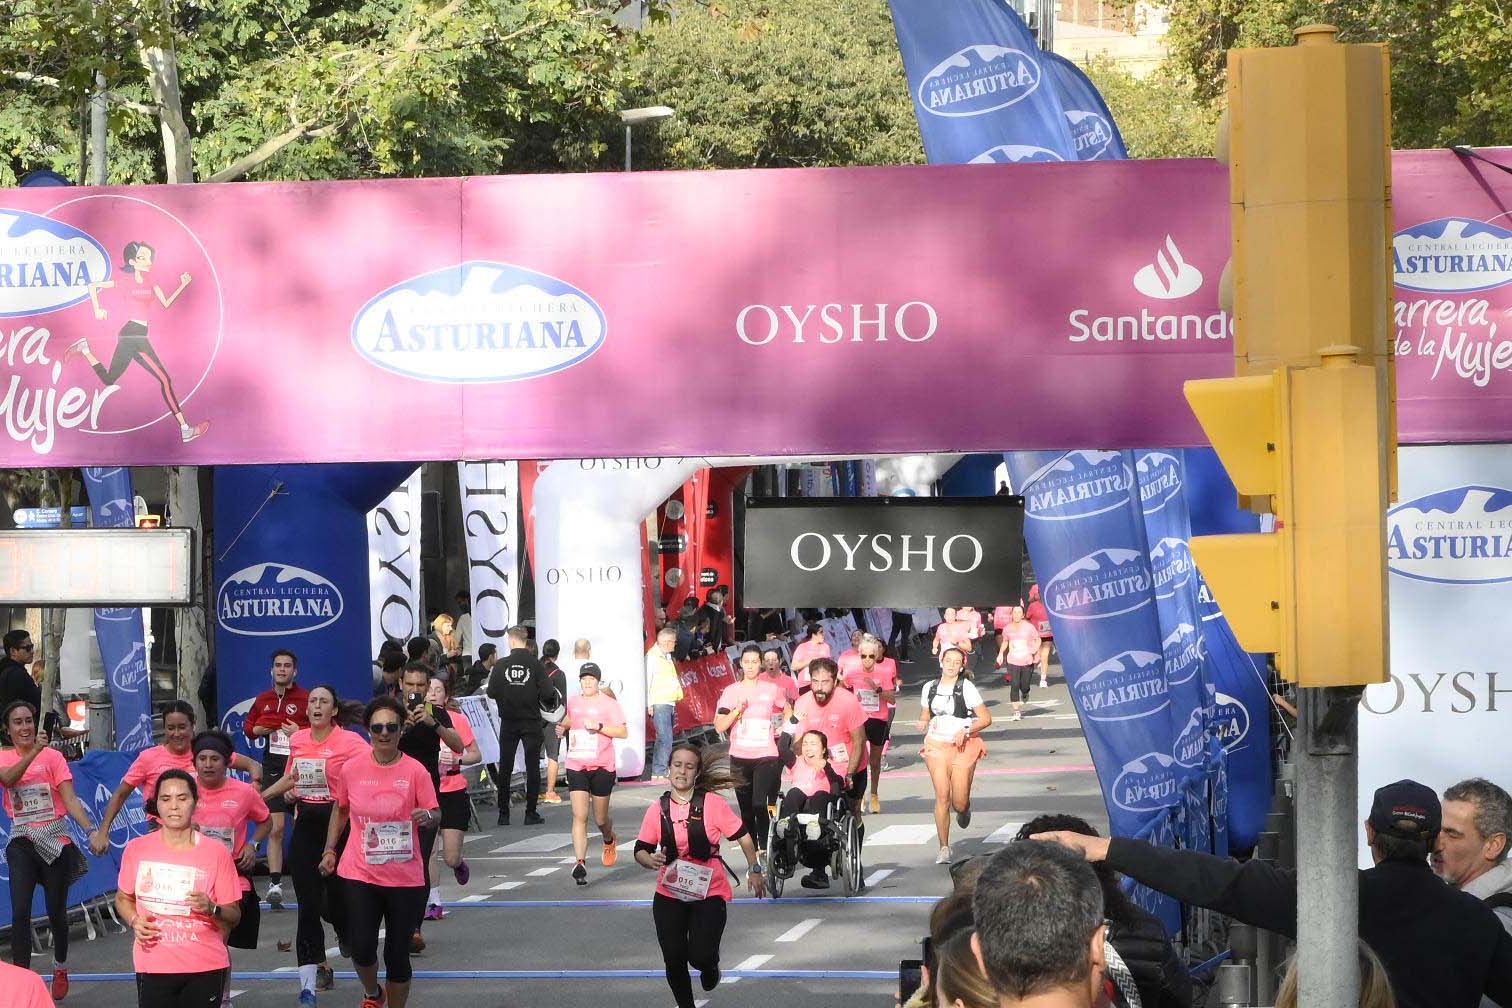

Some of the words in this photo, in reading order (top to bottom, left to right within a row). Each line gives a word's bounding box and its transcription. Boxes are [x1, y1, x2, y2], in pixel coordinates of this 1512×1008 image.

[14, 245, 87, 255] LECHERA
[1408, 243, 1457, 252] CENTRAL
[373, 307, 588, 352] ASTURIANA
[736, 301, 938, 345] OYSHO
[1068, 308, 1233, 342] Santand
[1418, 328, 1435, 356] la
[1415, 520, 1482, 530] CENTRAL
[790, 532, 984, 573] OYSHO
[546, 565, 623, 585] OYSHO
[233, 588, 276, 597] CENTRAL
[282, 587, 330, 596] LECHERA
[221, 596, 333, 618] ASTURIANA
[511, 669, 525, 679] BP
[678, 876, 694, 886] 016
